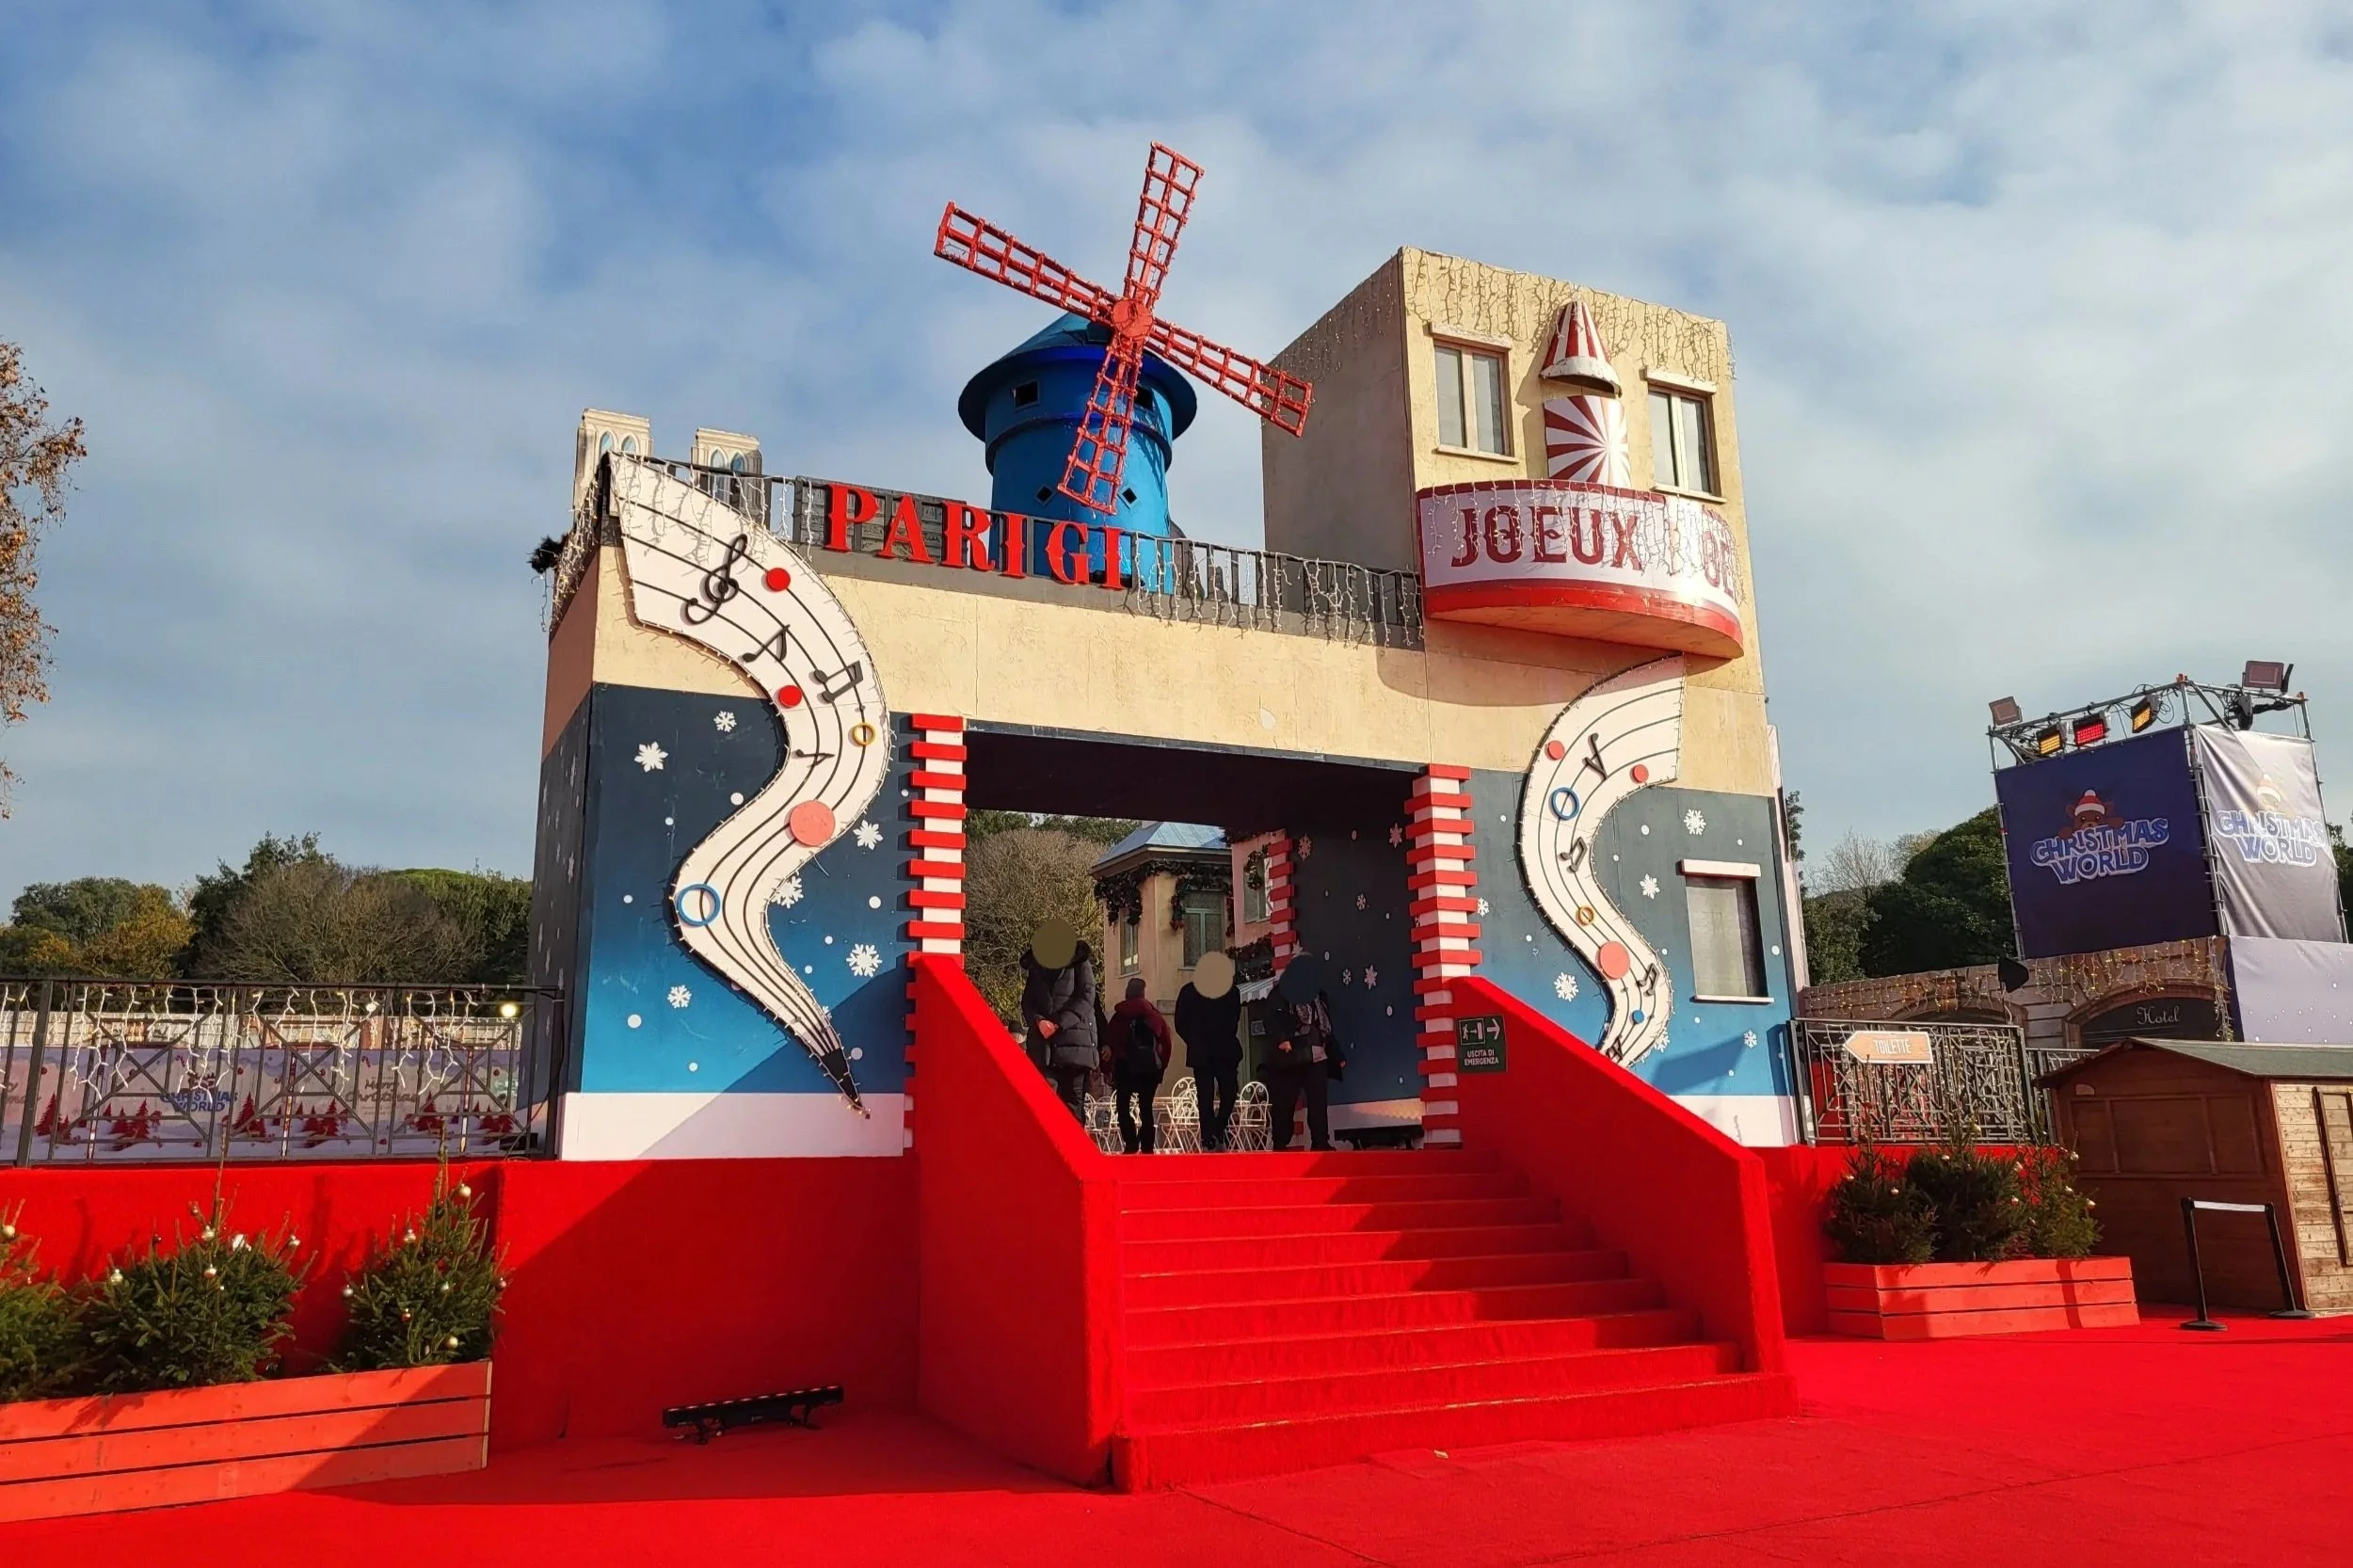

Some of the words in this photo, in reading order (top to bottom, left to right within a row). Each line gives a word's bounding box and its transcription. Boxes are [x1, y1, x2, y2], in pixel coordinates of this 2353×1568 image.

[824, 482, 1126, 590] PARIGI
[1450, 504, 1644, 571] JOEUX
[2030, 818, 2170, 867] CHRISTMAS
[2214, 809, 2327, 847] CHISTMAS
[2050, 845, 2150, 885] WORLD
[2235, 836, 2316, 867] WORLD
[2137, 1005, 2181, 1025] Hotel
[1464, 1056, 1499, 1066] EMERGENZA
[1466, 1049, 1487, 1058] USCITA
[1874, 1038, 1912, 1054] TOILETTE
